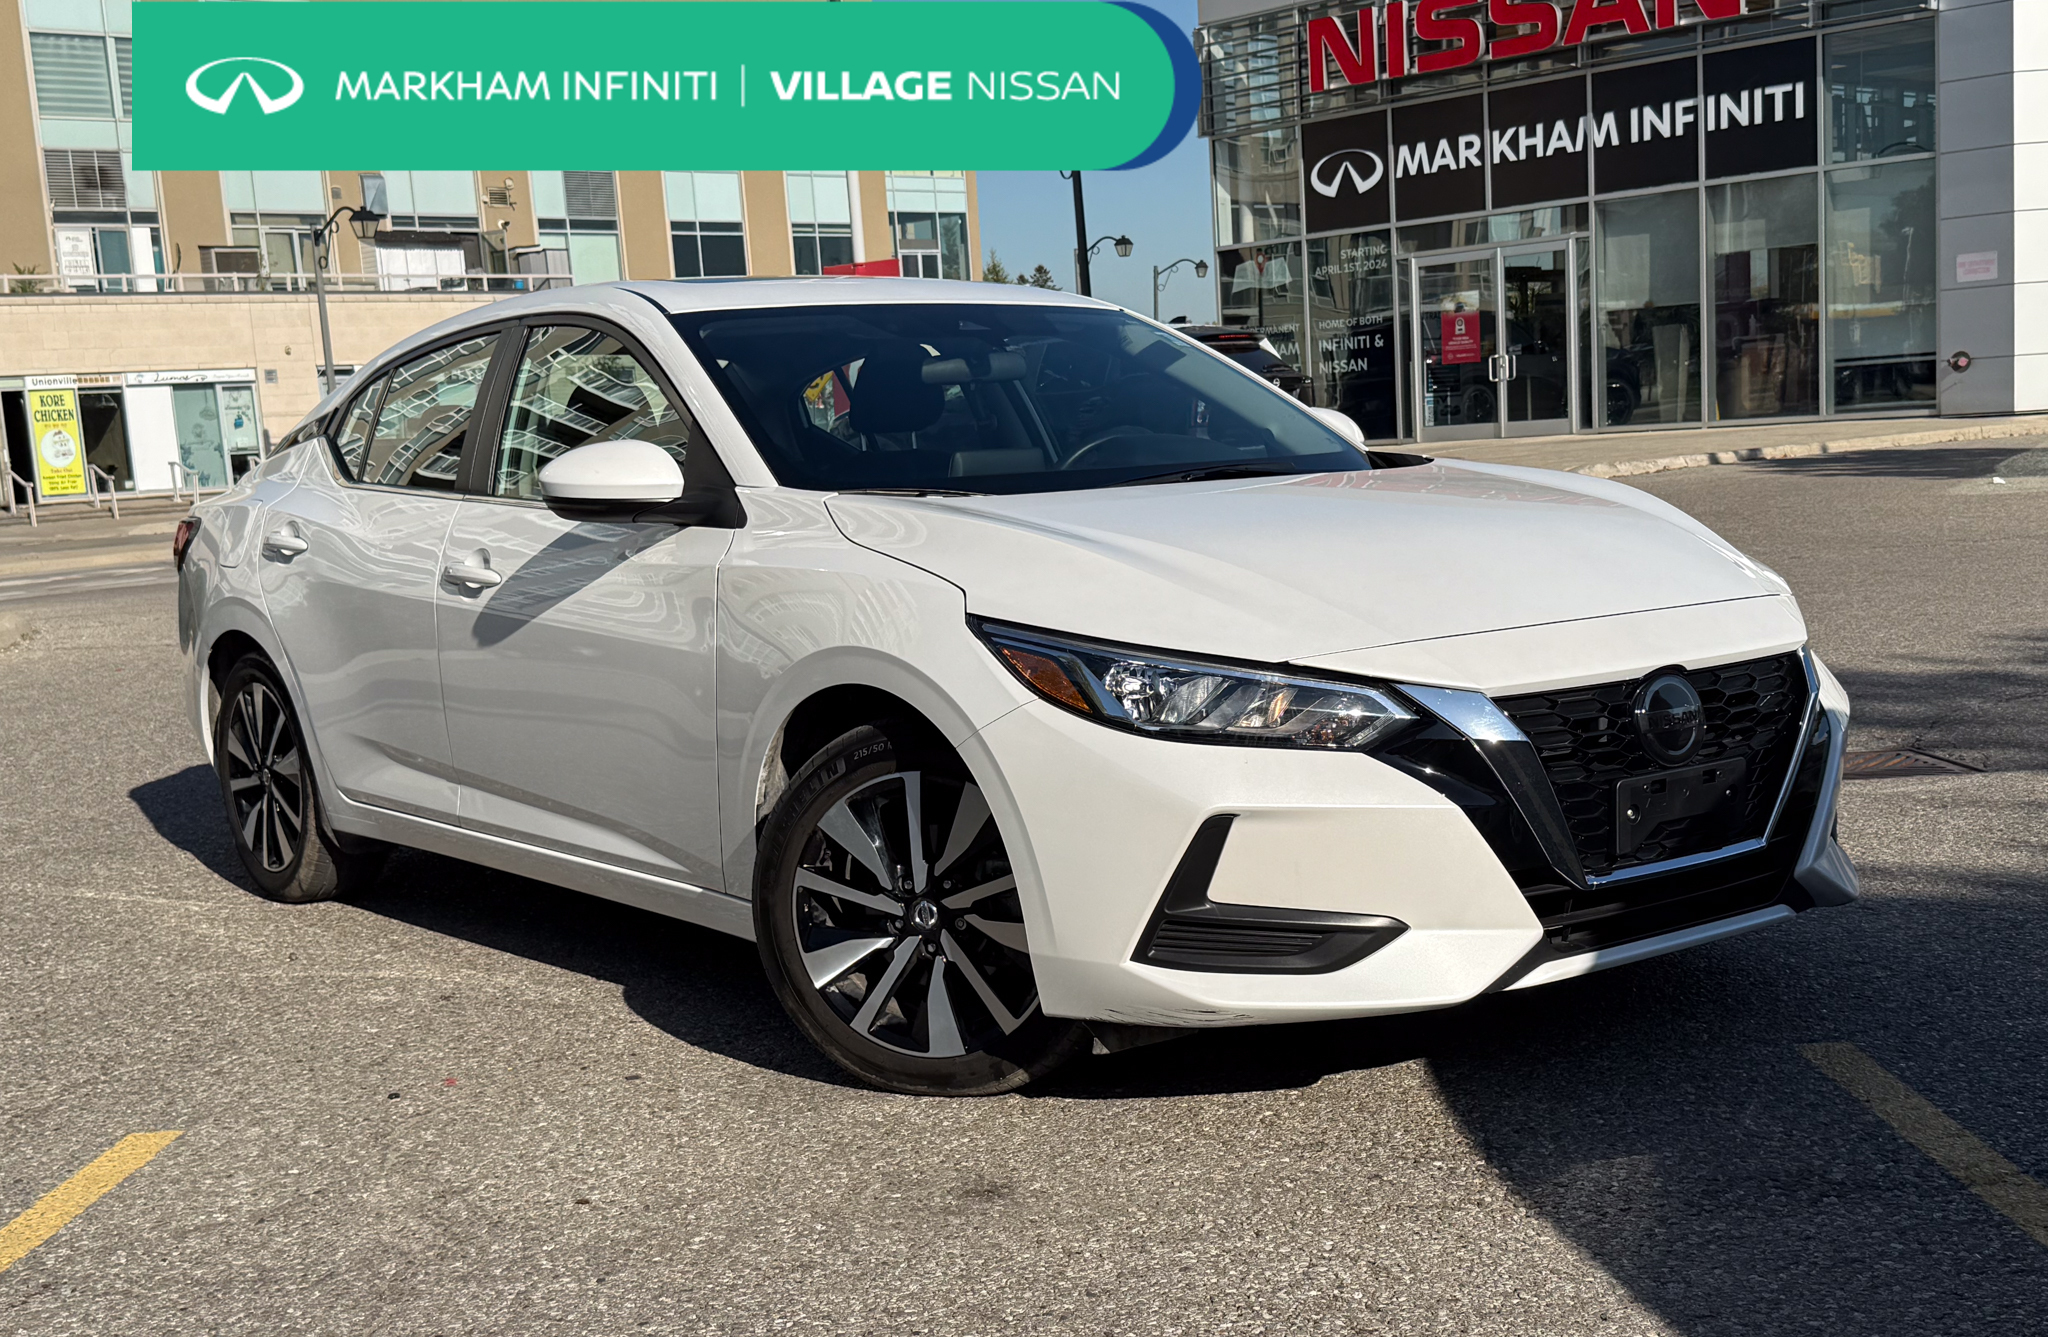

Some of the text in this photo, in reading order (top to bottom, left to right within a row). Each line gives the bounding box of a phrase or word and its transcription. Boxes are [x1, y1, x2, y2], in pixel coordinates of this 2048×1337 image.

[1396, 82, 1805, 178] MARKHAM INFINITI
[1340, 244, 1388, 260] STARTING
[1315, 264, 1342, 276] APRIL
[1363, 259, 1387, 271] 2024
[1319, 315, 1383, 330] HOME OF BOTH
[1318, 333, 1384, 352] INFINITI &
[1319, 357, 1368, 374] NISSAN
[32, 377, 77, 386] Unionville
[39, 395, 65, 407] KORE
[34, 409, 75, 422] CHICKEN
[853, 742, 885, 761] 215/50
